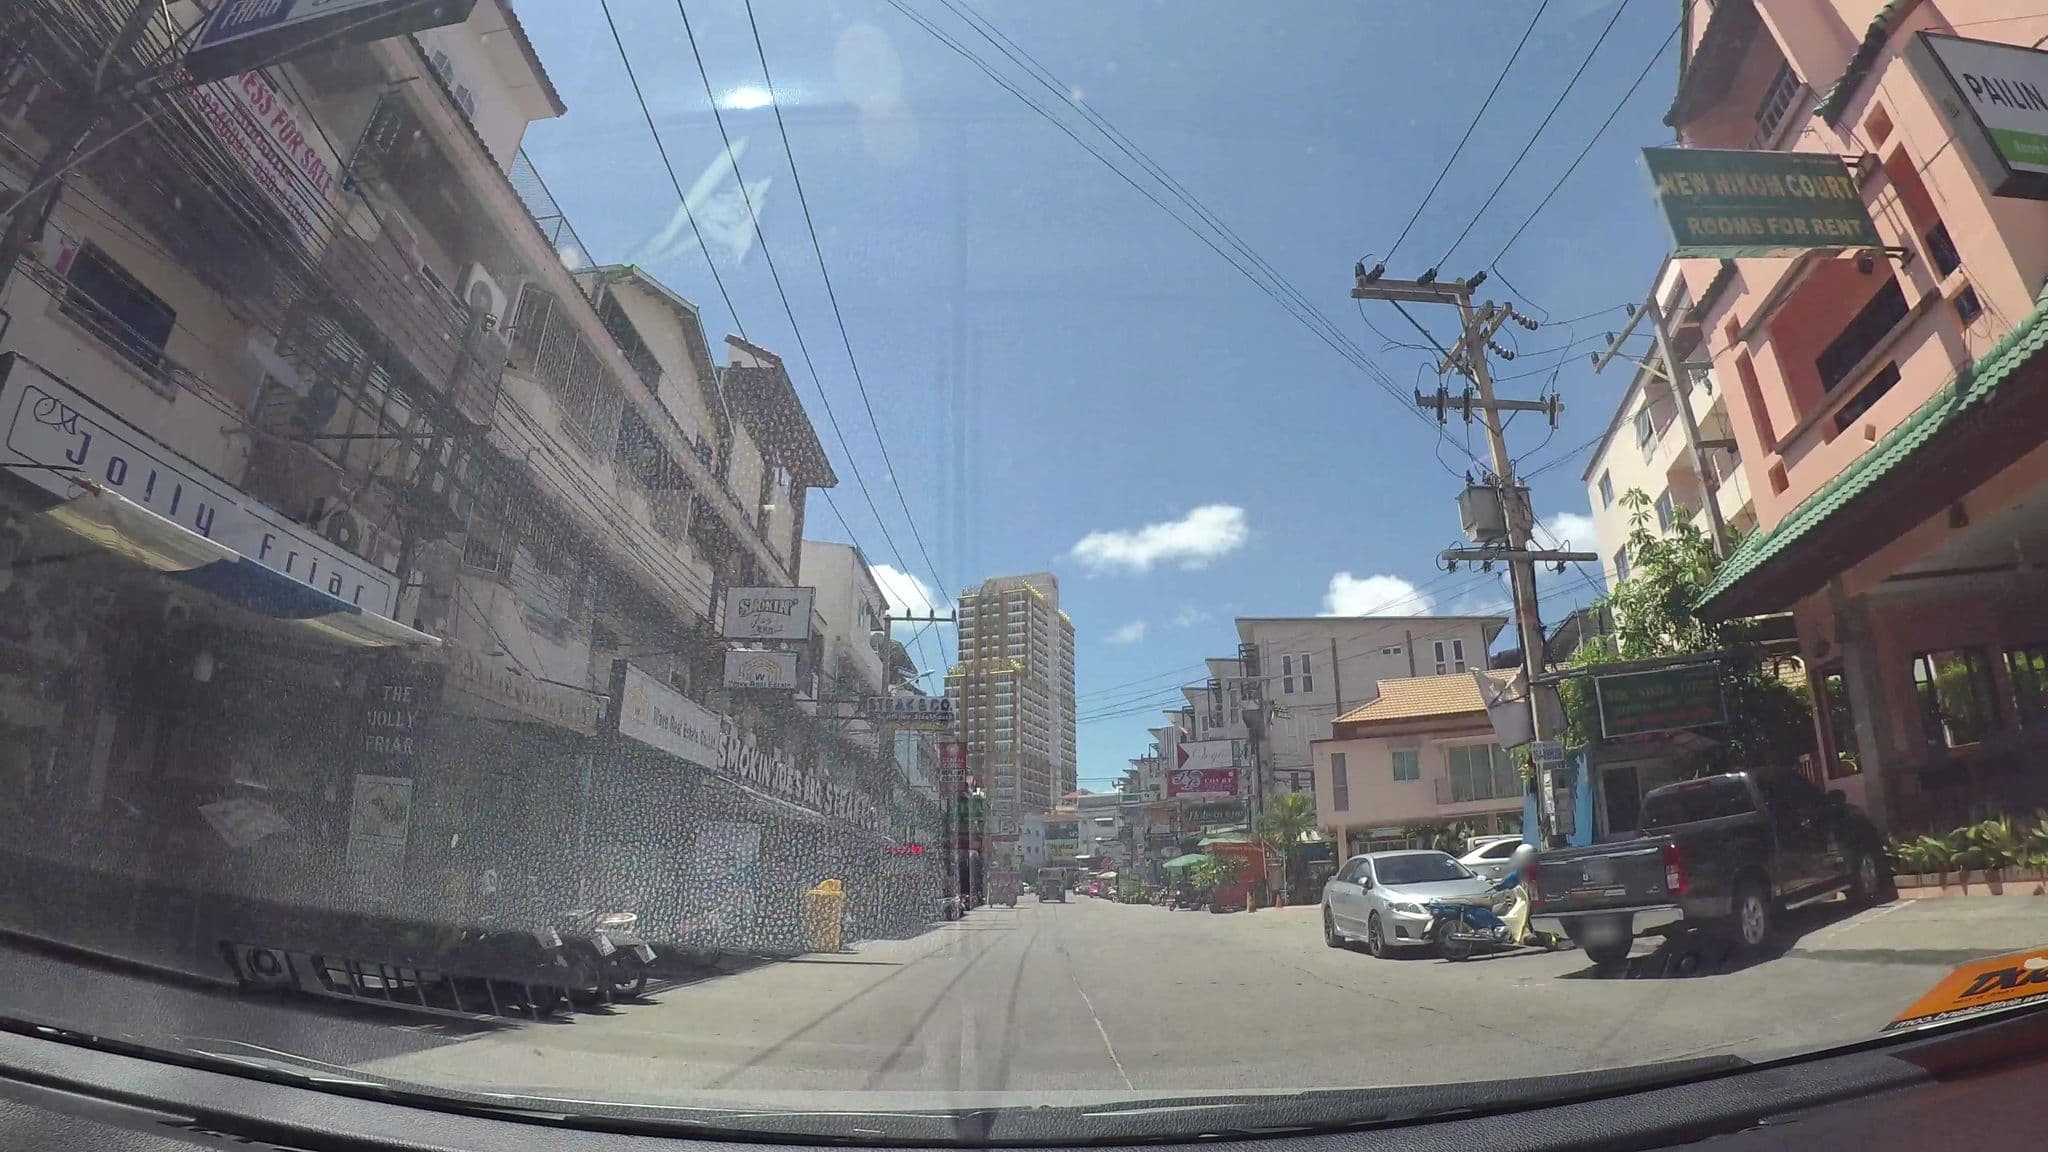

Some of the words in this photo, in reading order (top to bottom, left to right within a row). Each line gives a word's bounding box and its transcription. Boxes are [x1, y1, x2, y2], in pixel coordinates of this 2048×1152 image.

[271, 108, 304, 156] FOR
[1660, 171, 1711, 196] NEW
[1785, 174, 1854, 199] COURT
[1687, 216, 1764, 235] ROOMS
[1766, 217, 1809, 235] FOR
[1811, 218, 1861, 235] RENT
[65, 429, 215, 539] Jolly
[383, 686, 413, 702] THE
[367, 710, 418, 728] JOLLY
[365, 734, 414, 754] FRIAR
